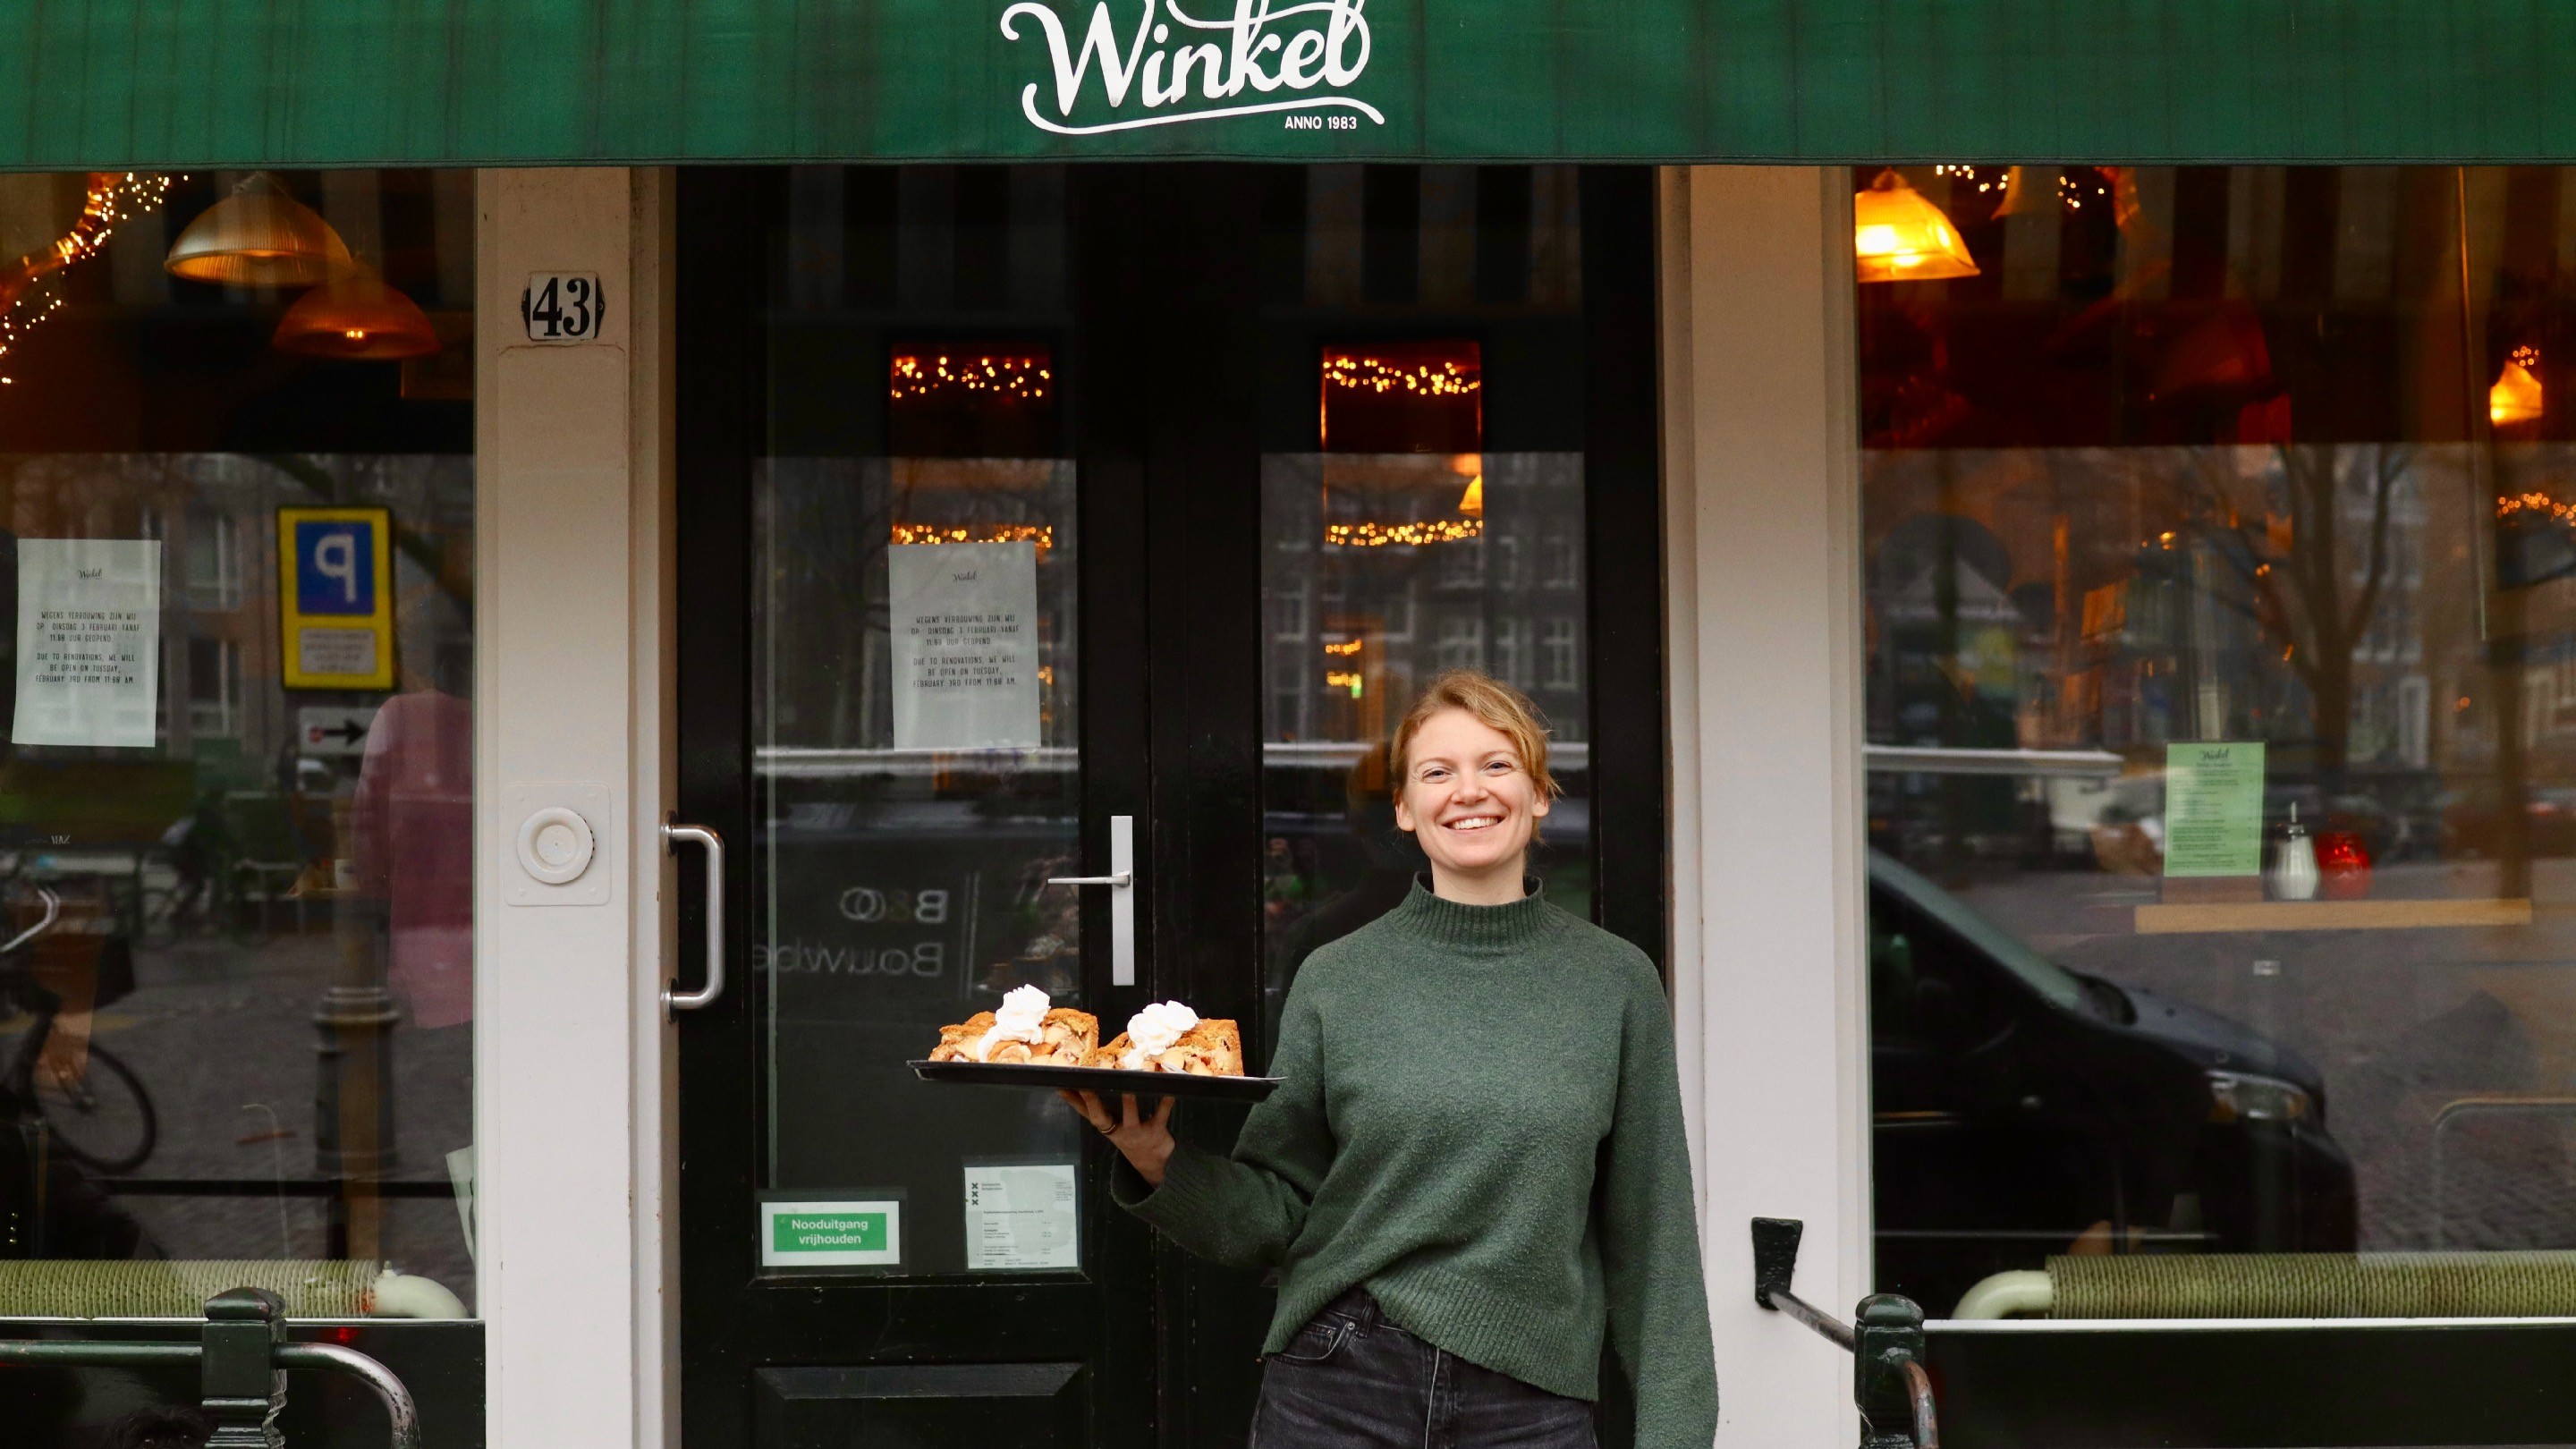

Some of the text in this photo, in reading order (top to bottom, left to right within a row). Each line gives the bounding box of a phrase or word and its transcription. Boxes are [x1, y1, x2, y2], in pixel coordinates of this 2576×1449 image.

[1000, 0, 1371, 117] Winkel
[1284, 115, 1357, 130] ANNO 1983
[532, 276, 590, 336] 43
[41, 612, 64, 620] WEGENS
[68, 612, 105, 620] VERBOUWING
[109, 612, 122, 620] ZIJN
[916, 614, 1015, 624] WEGENS VERBOUWING ZIJN WIJ
[52, 623, 77, 631] DINSDAG
[89, 623, 117, 631] FEBRUARI
[928, 627, 954, 635] DINSDAG
[967, 625, 996, 634] FEBRUARI
[946, 638, 959, 646] UUR
[109, 654, 116, 662] WE
[121, 654, 135, 662] WILL
[913, 657, 925, 665] DUE
[930, 657, 937, 665] TO
[989, 656, 996, 664] WE
[1002, 655, 1015, 663] WILL
[49, 664, 57, 672] BE
[928, 668, 935, 676] BE
[940, 668, 955, 676] OPEN
[960, 667, 969, 675] ON
[70, 675, 80, 683] 3RD
[913, 680, 944, 688] FEBRUARY
[949, 679, 961, 687] 3RD
[965, 679, 982, 687] FROM
[792, 1218, 869, 1233] Nooduitgang
[799, 1233, 861, 1246] vrijhouden
